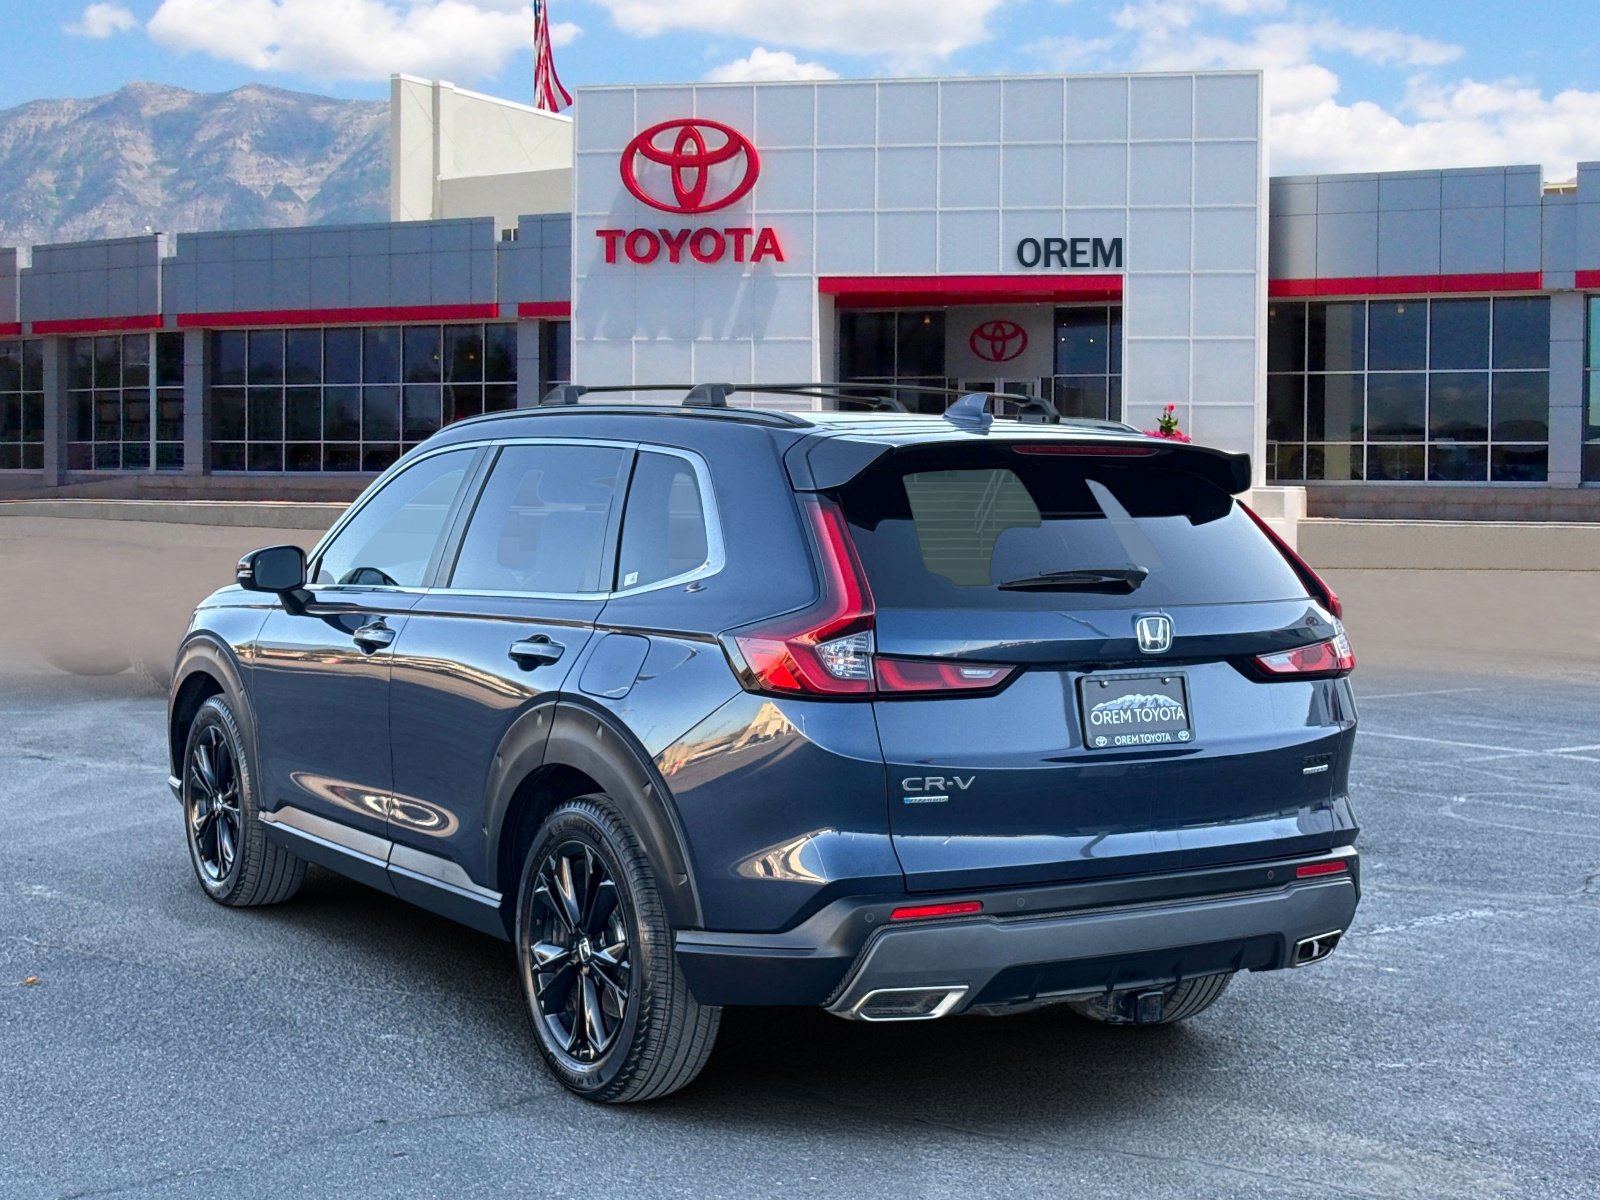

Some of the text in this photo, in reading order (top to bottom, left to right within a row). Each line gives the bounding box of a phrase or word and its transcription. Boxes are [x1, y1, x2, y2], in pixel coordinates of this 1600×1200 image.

[596, 227, 784, 264] TOYOTA
[1017, 237, 1122, 268] OREM
[1091, 706, 1186, 725] OREM TOYOTA
[1115, 732, 1171, 746] OREM TOYOTA
[902, 776, 976, 791] CR-V
